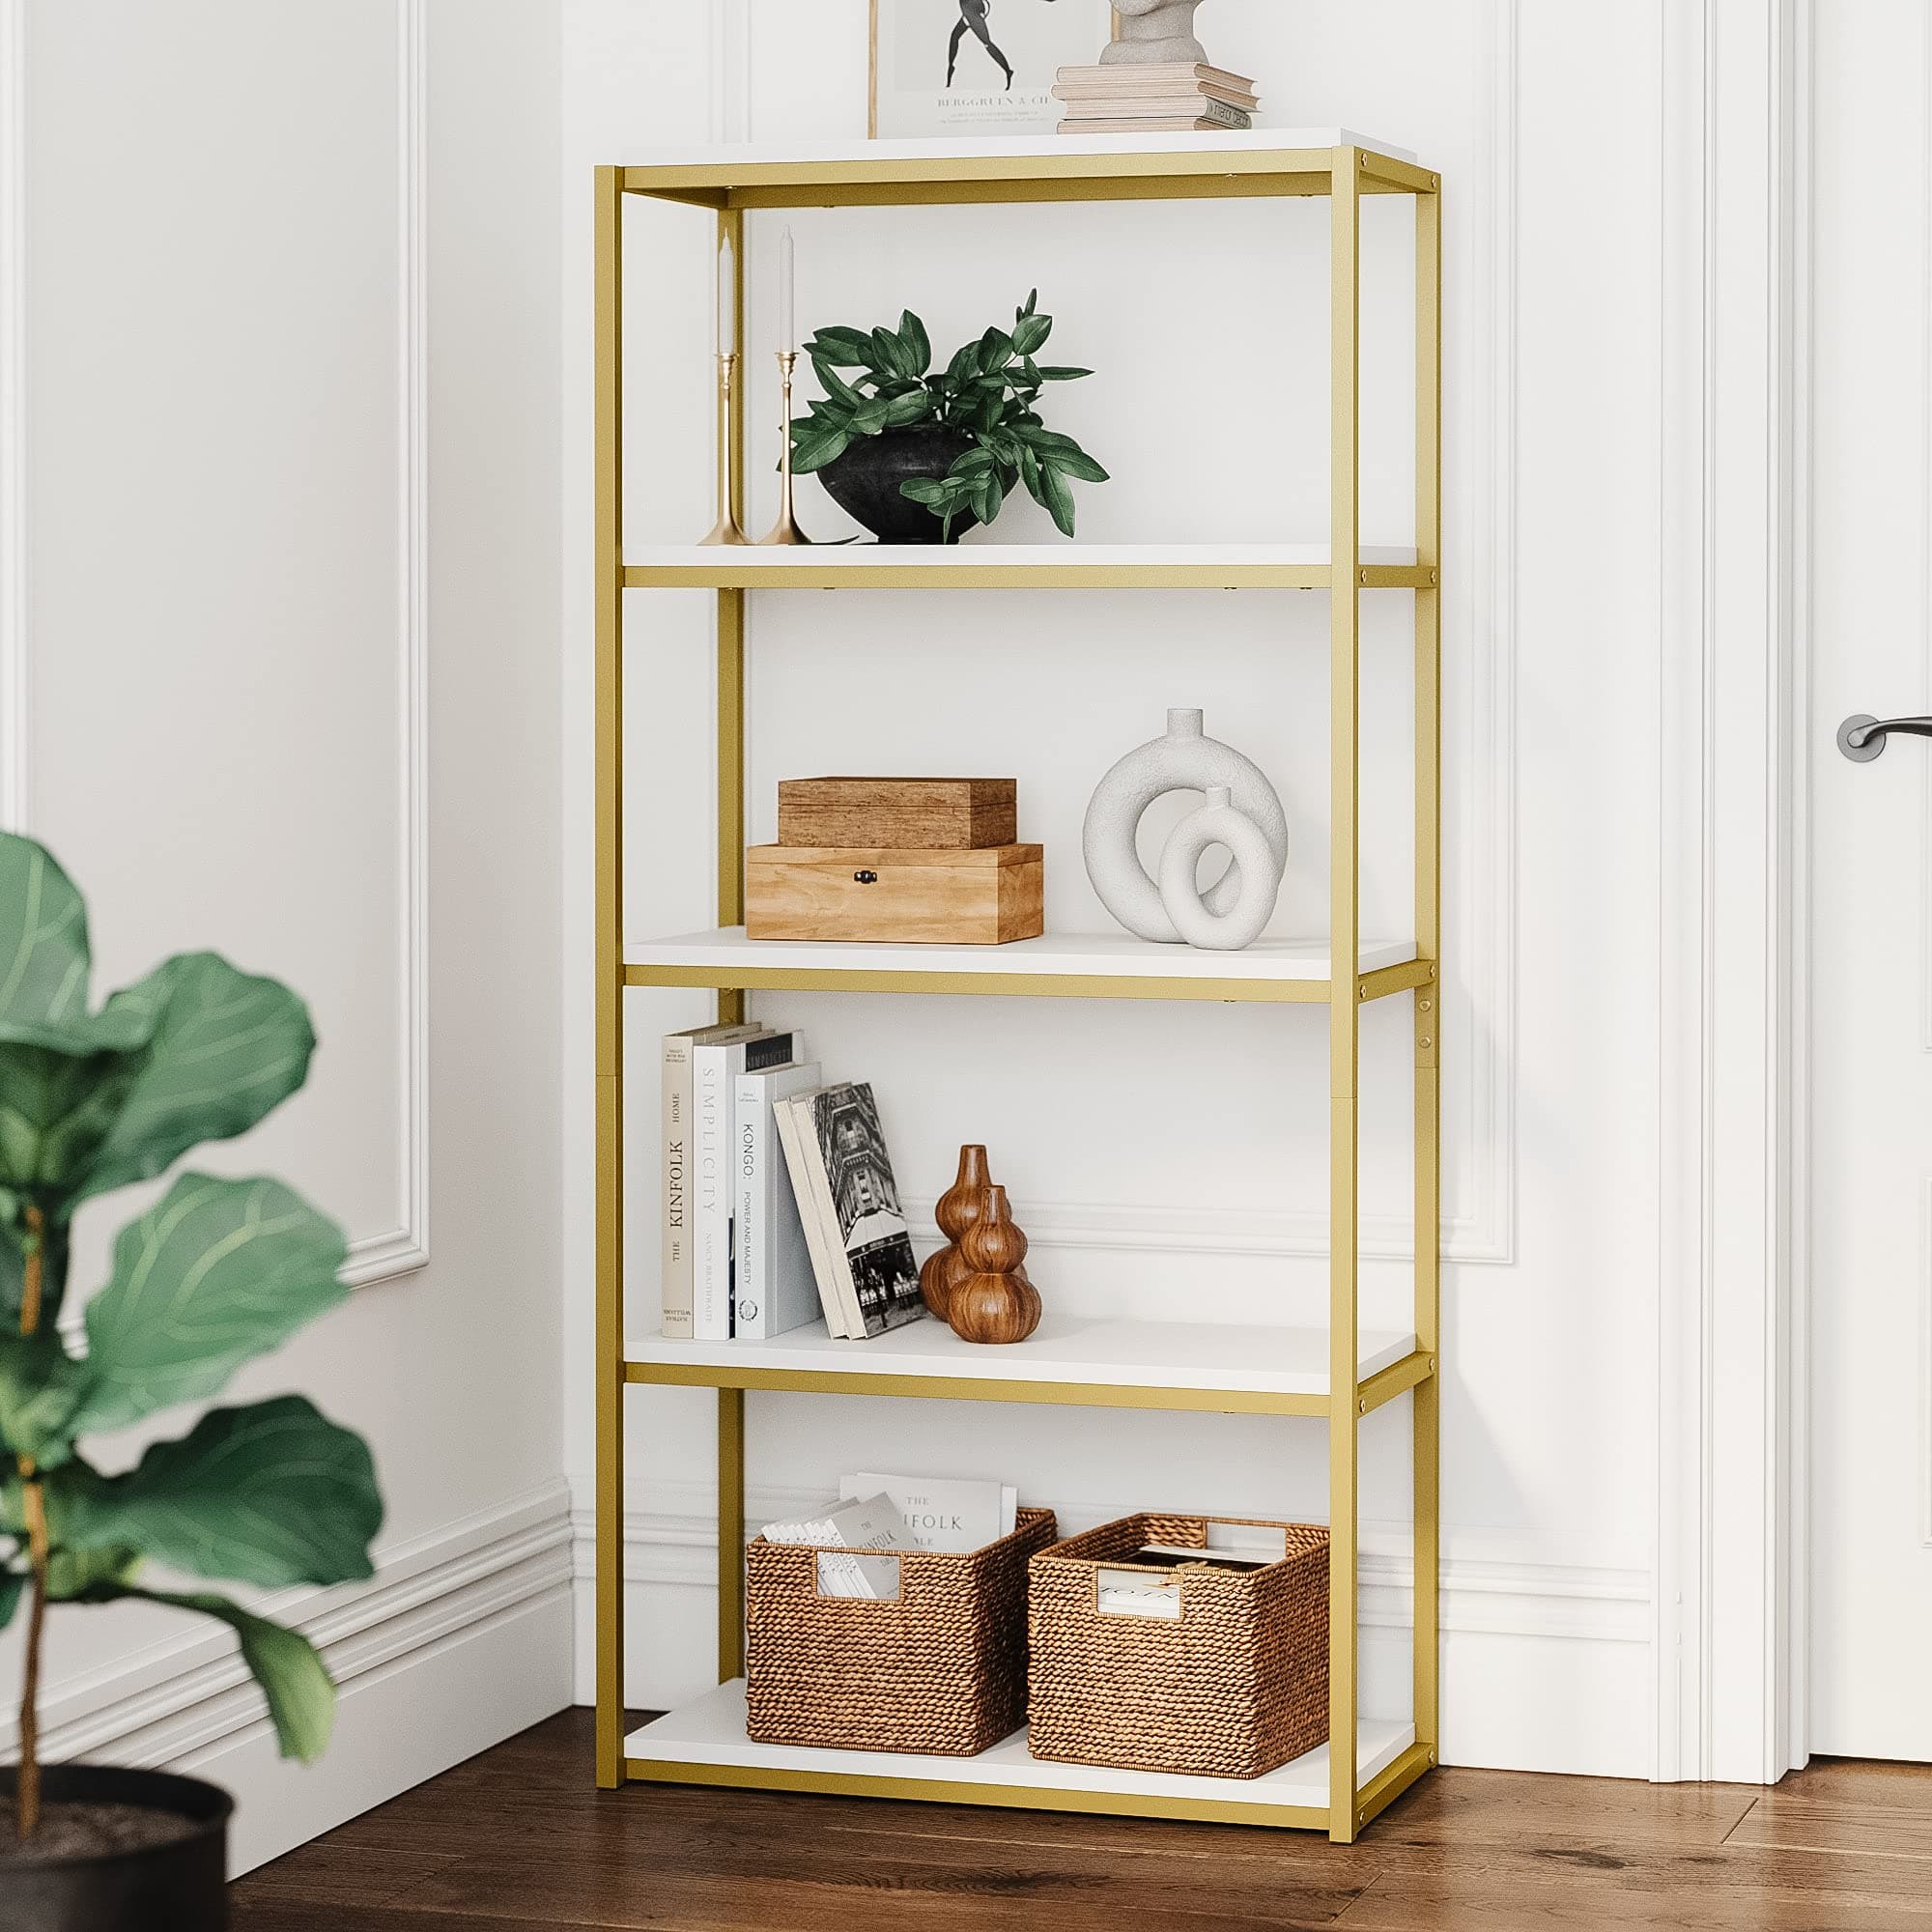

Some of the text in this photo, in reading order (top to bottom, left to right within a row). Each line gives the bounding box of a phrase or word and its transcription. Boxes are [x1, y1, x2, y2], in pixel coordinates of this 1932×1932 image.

[702, 1067, 716, 1213] SIMPLICITY
[743, 1123, 753, 1179] KONGO:
[669, 1141, 683, 1229] KINFOLK
